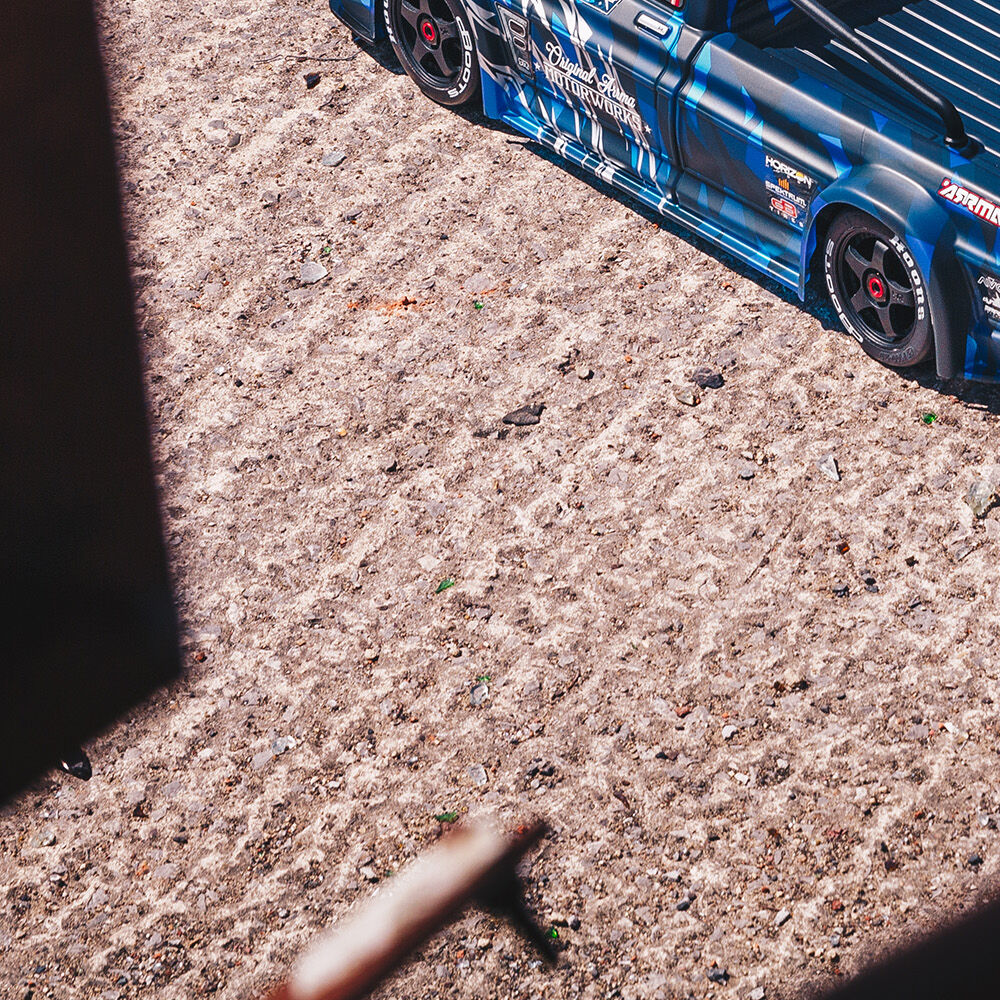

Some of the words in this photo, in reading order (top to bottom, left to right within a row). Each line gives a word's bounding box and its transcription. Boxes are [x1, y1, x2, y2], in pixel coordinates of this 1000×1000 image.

[544, 64, 643, 132] MOTORWORKS
[546, 42, 597, 84] Original
[598, 74, 636, 108] Arrma
[765, 155, 813, 189] HORIZON
[765, 180, 807, 208] SPEKTRUM
